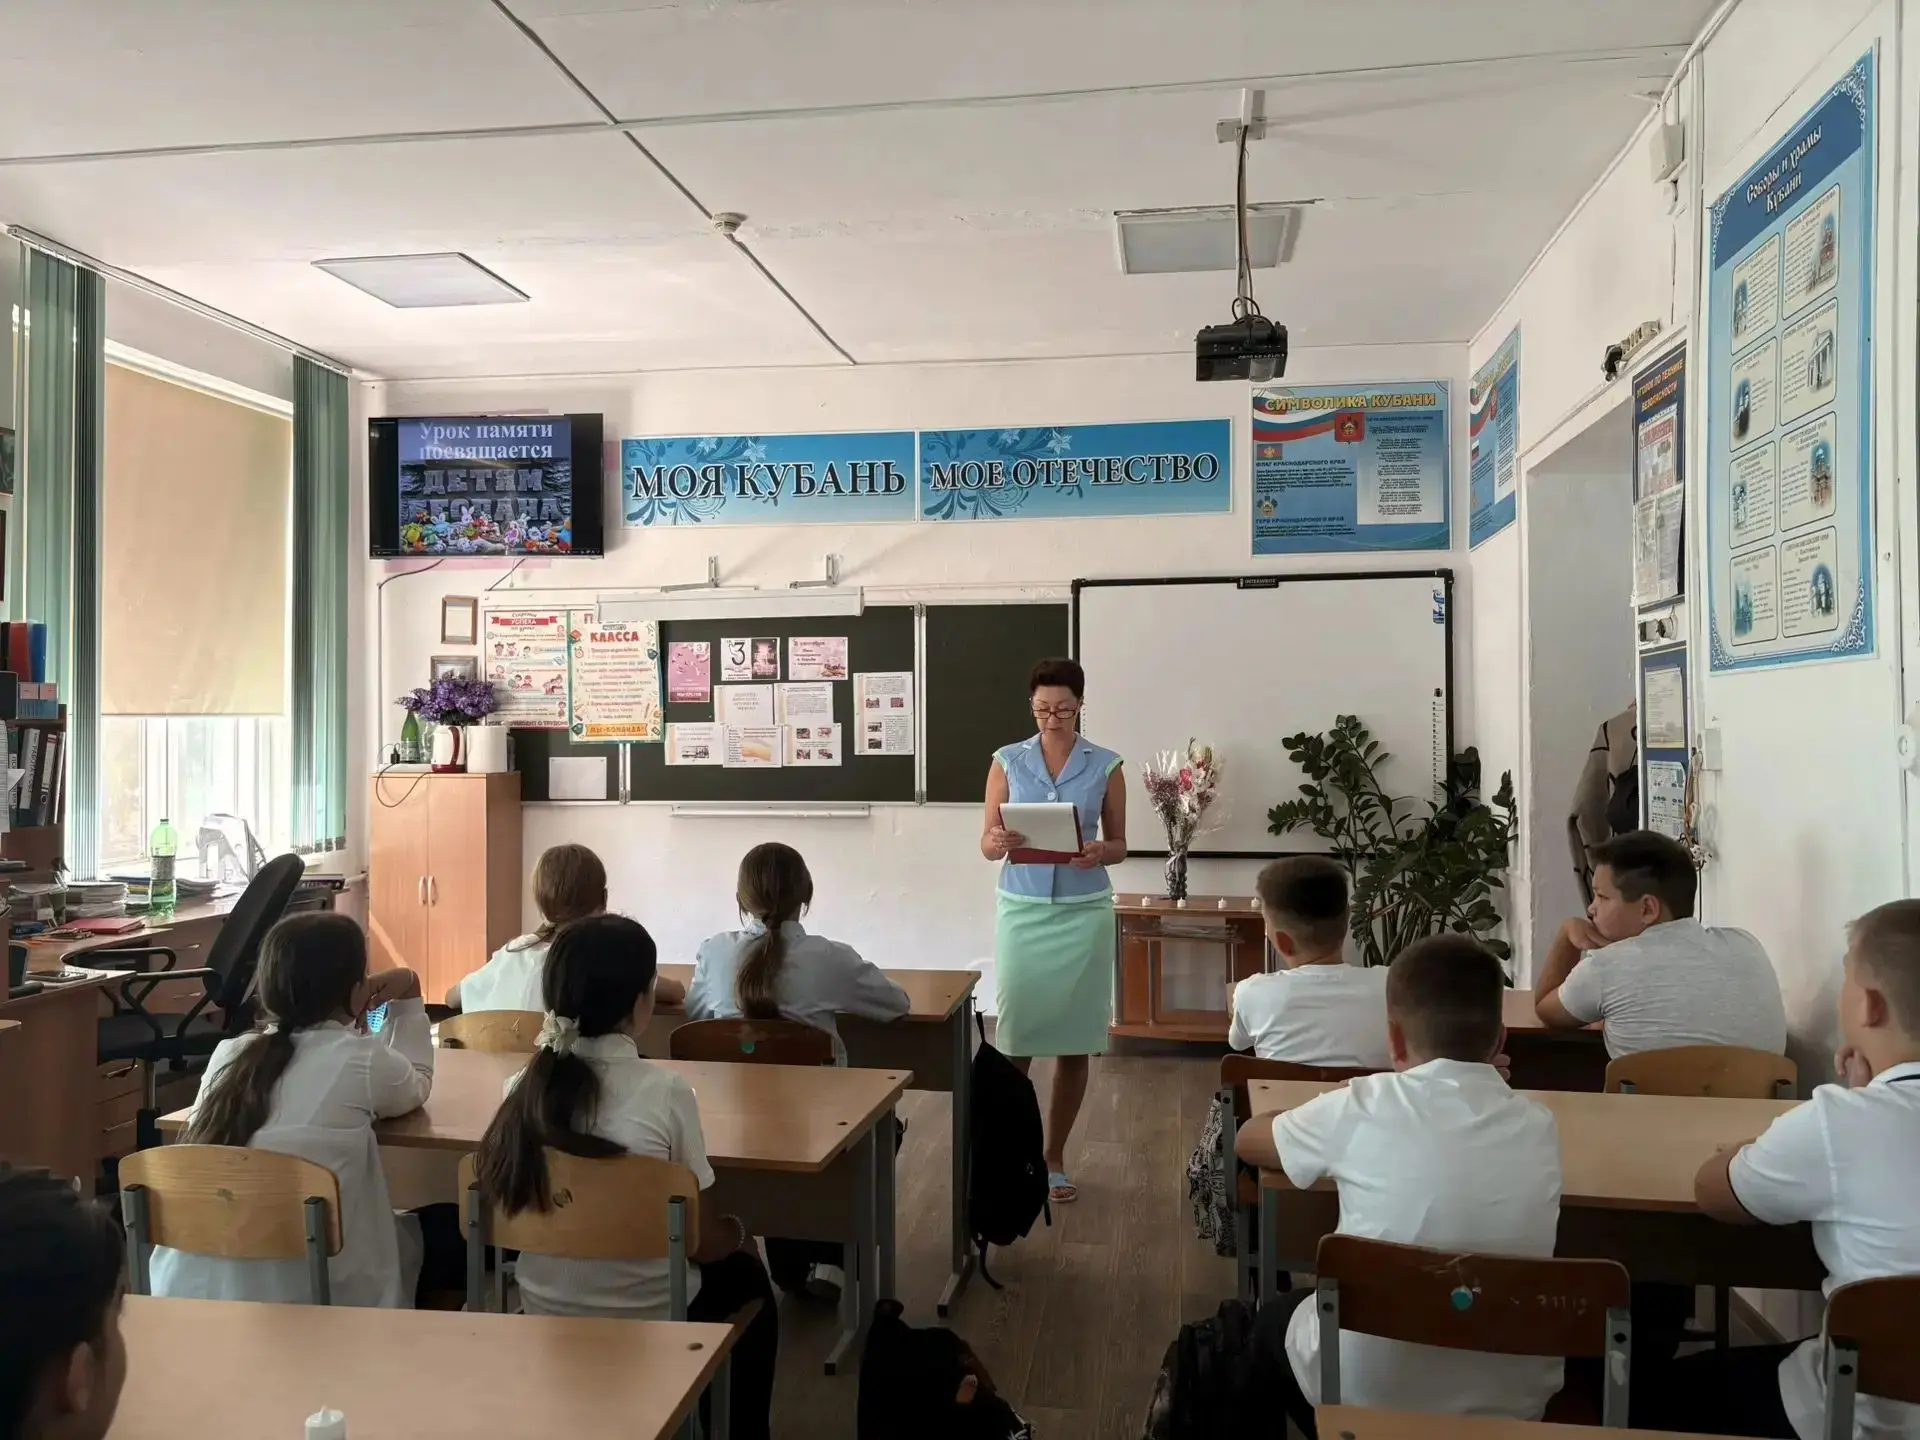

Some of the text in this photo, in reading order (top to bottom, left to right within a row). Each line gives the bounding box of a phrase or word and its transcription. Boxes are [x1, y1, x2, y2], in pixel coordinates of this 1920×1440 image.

[1747, 164, 1780, 203] Соборы
[1788, 125, 1822, 171] храмы
[1766, 171, 1802, 213] Кубани
[1264, 392, 1437, 412] СИМВОЛИКА КУБАНИ
[420, 422, 553, 444] Урок памяти
[631, 461, 907, 499] МОЯ КУБАНЬ
[930, 460, 1004, 490] МОЕ
[1011, 452, 1219, 488] ОТЕЧЕСТВО
[590, 631, 640, 643] КЛАССА
[732, 641, 746, 666] 3
